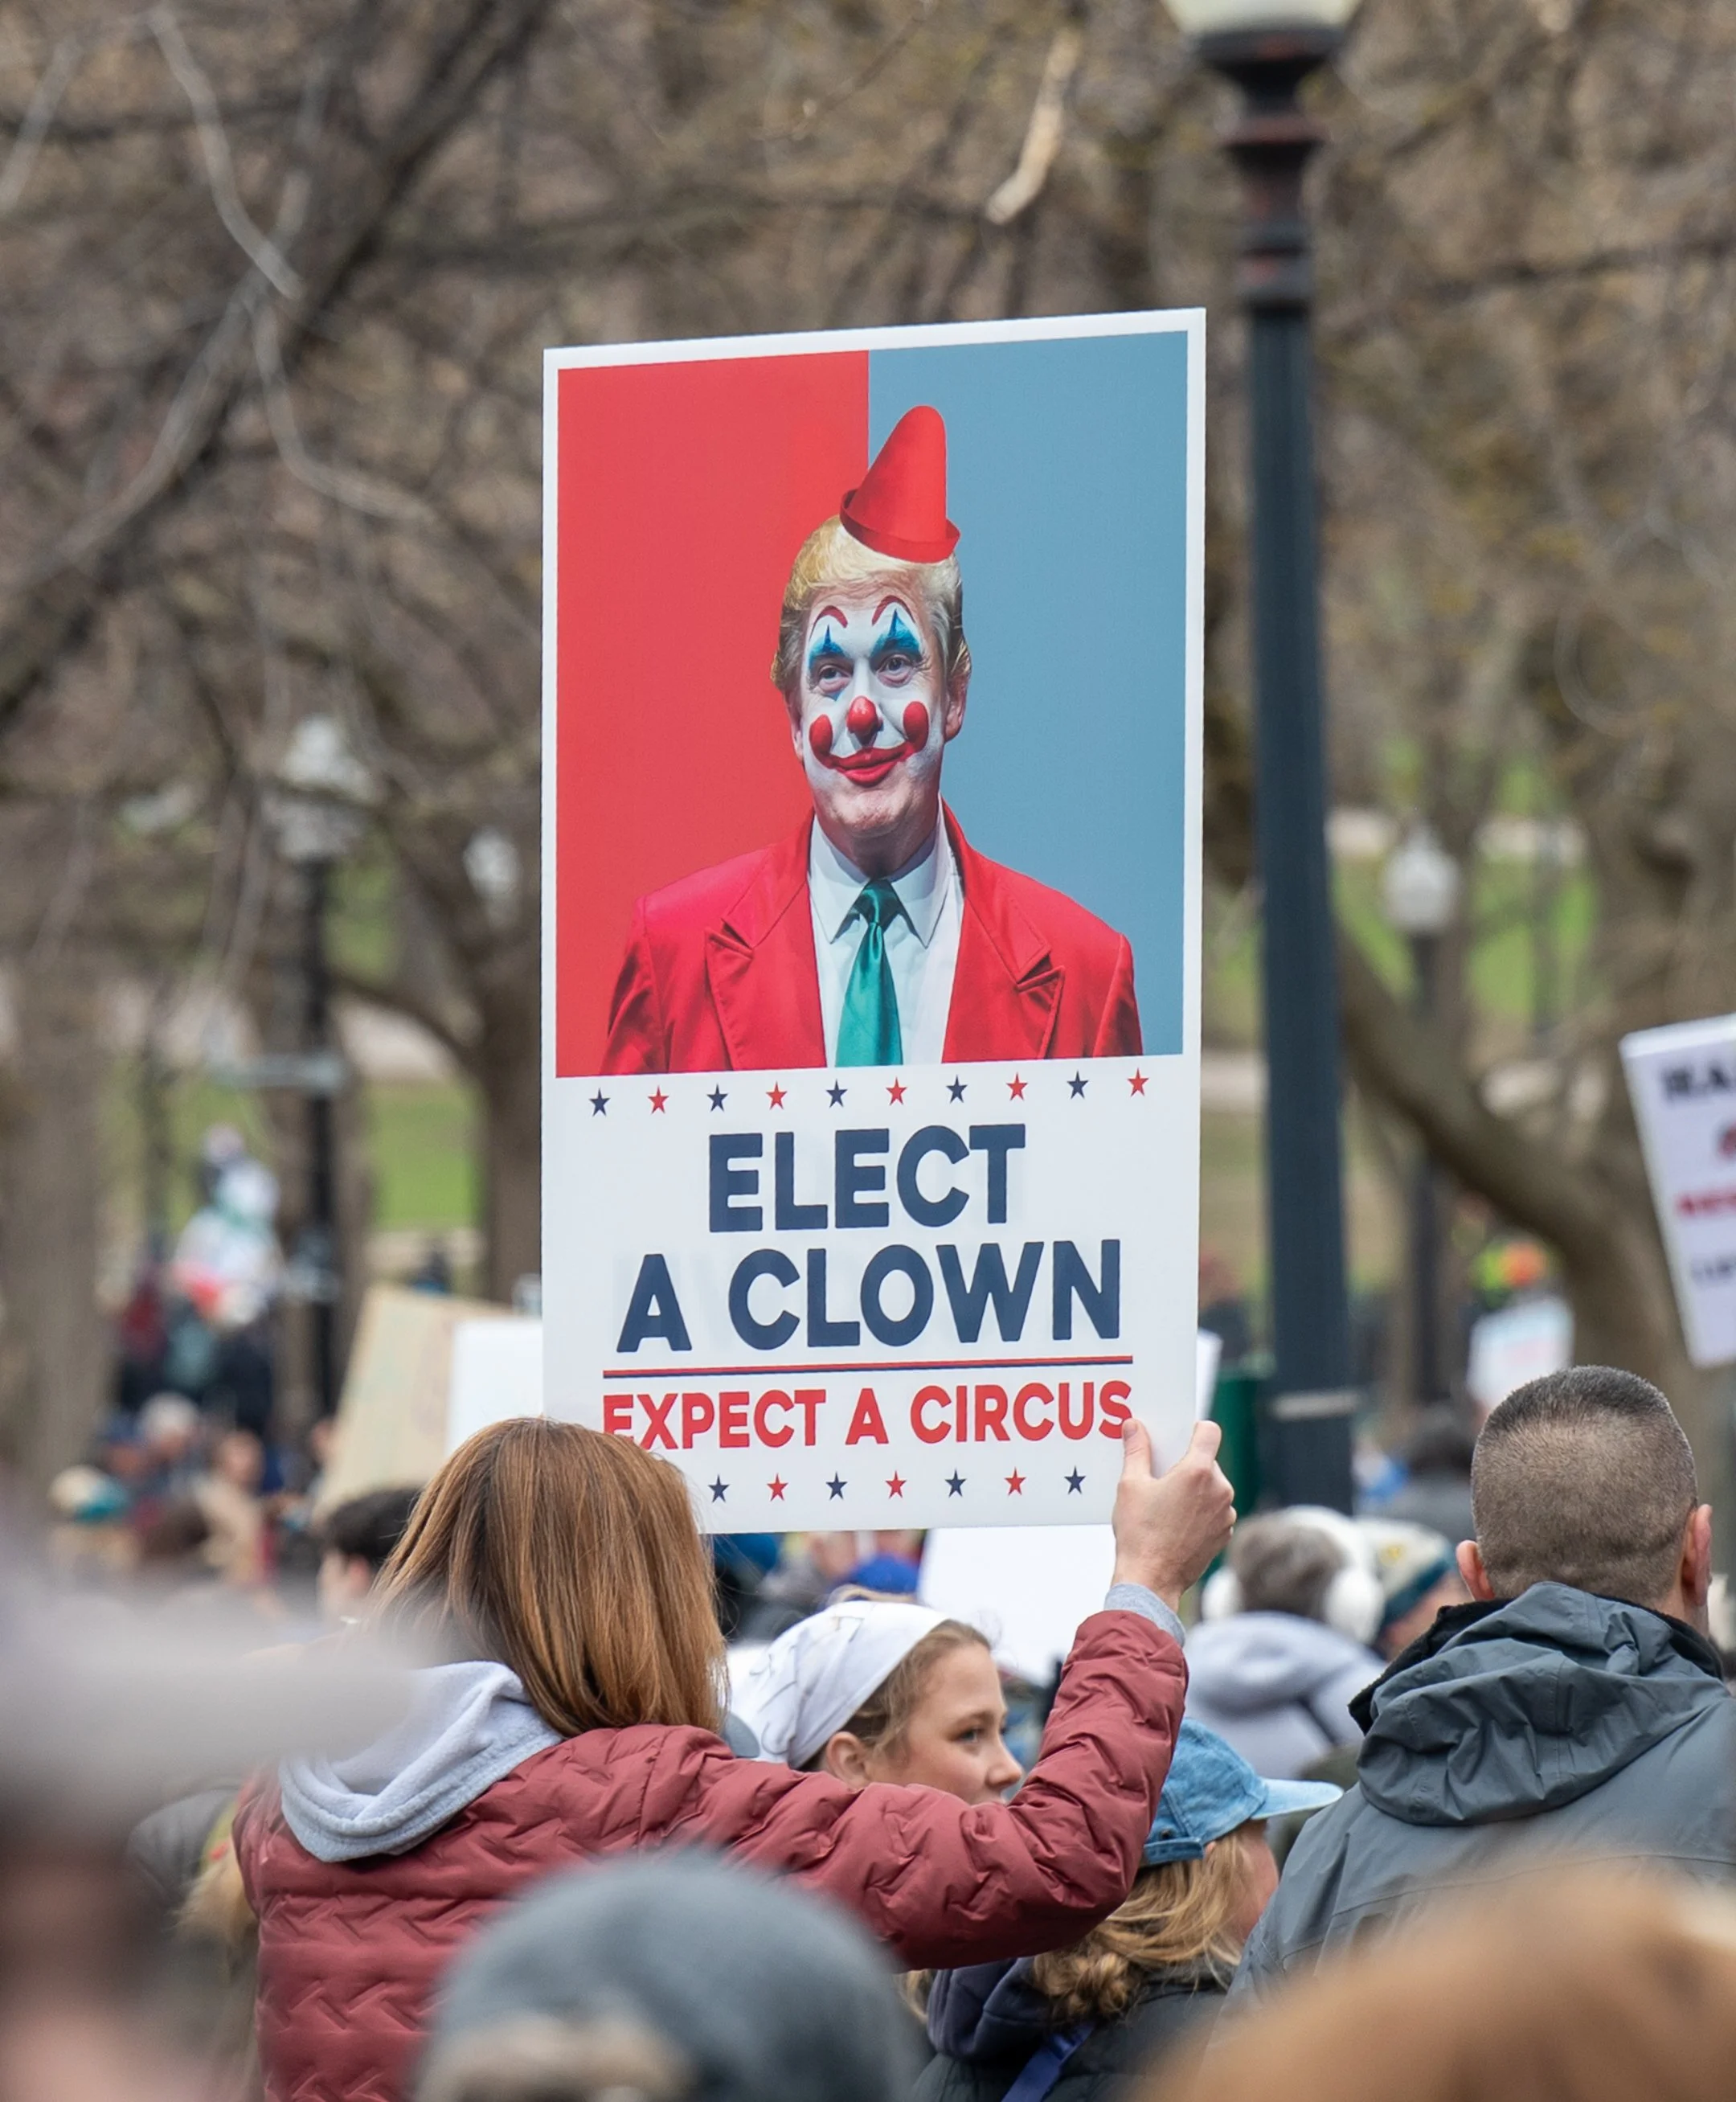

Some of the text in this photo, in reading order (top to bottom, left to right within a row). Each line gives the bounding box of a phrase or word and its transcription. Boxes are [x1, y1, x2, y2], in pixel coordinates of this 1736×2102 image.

[709, 1124, 1026, 1233] ELECT
[616, 1239, 1120, 1354] A CLOWN
[603, 1380, 1132, 1450] EXPECT A CIRCUS
